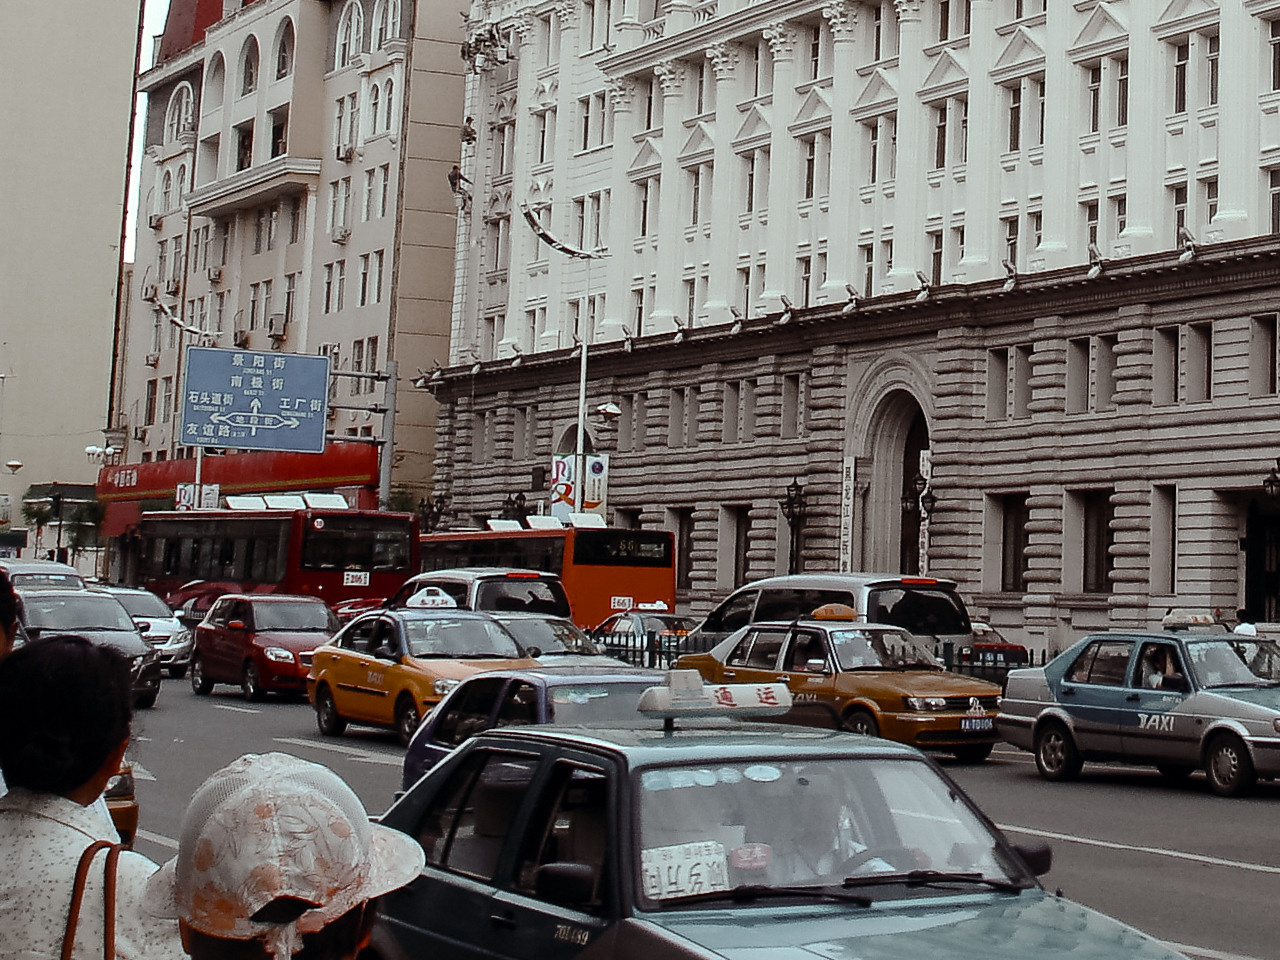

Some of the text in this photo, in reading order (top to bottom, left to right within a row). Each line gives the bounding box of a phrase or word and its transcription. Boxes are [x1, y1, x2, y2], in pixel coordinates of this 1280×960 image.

[231, 354, 286, 370] 景阳街
[188, 391, 234, 405] 石头道街
[279, 398, 322, 411] 工厂街
[1137, 713, 1175, 731] TAXI
